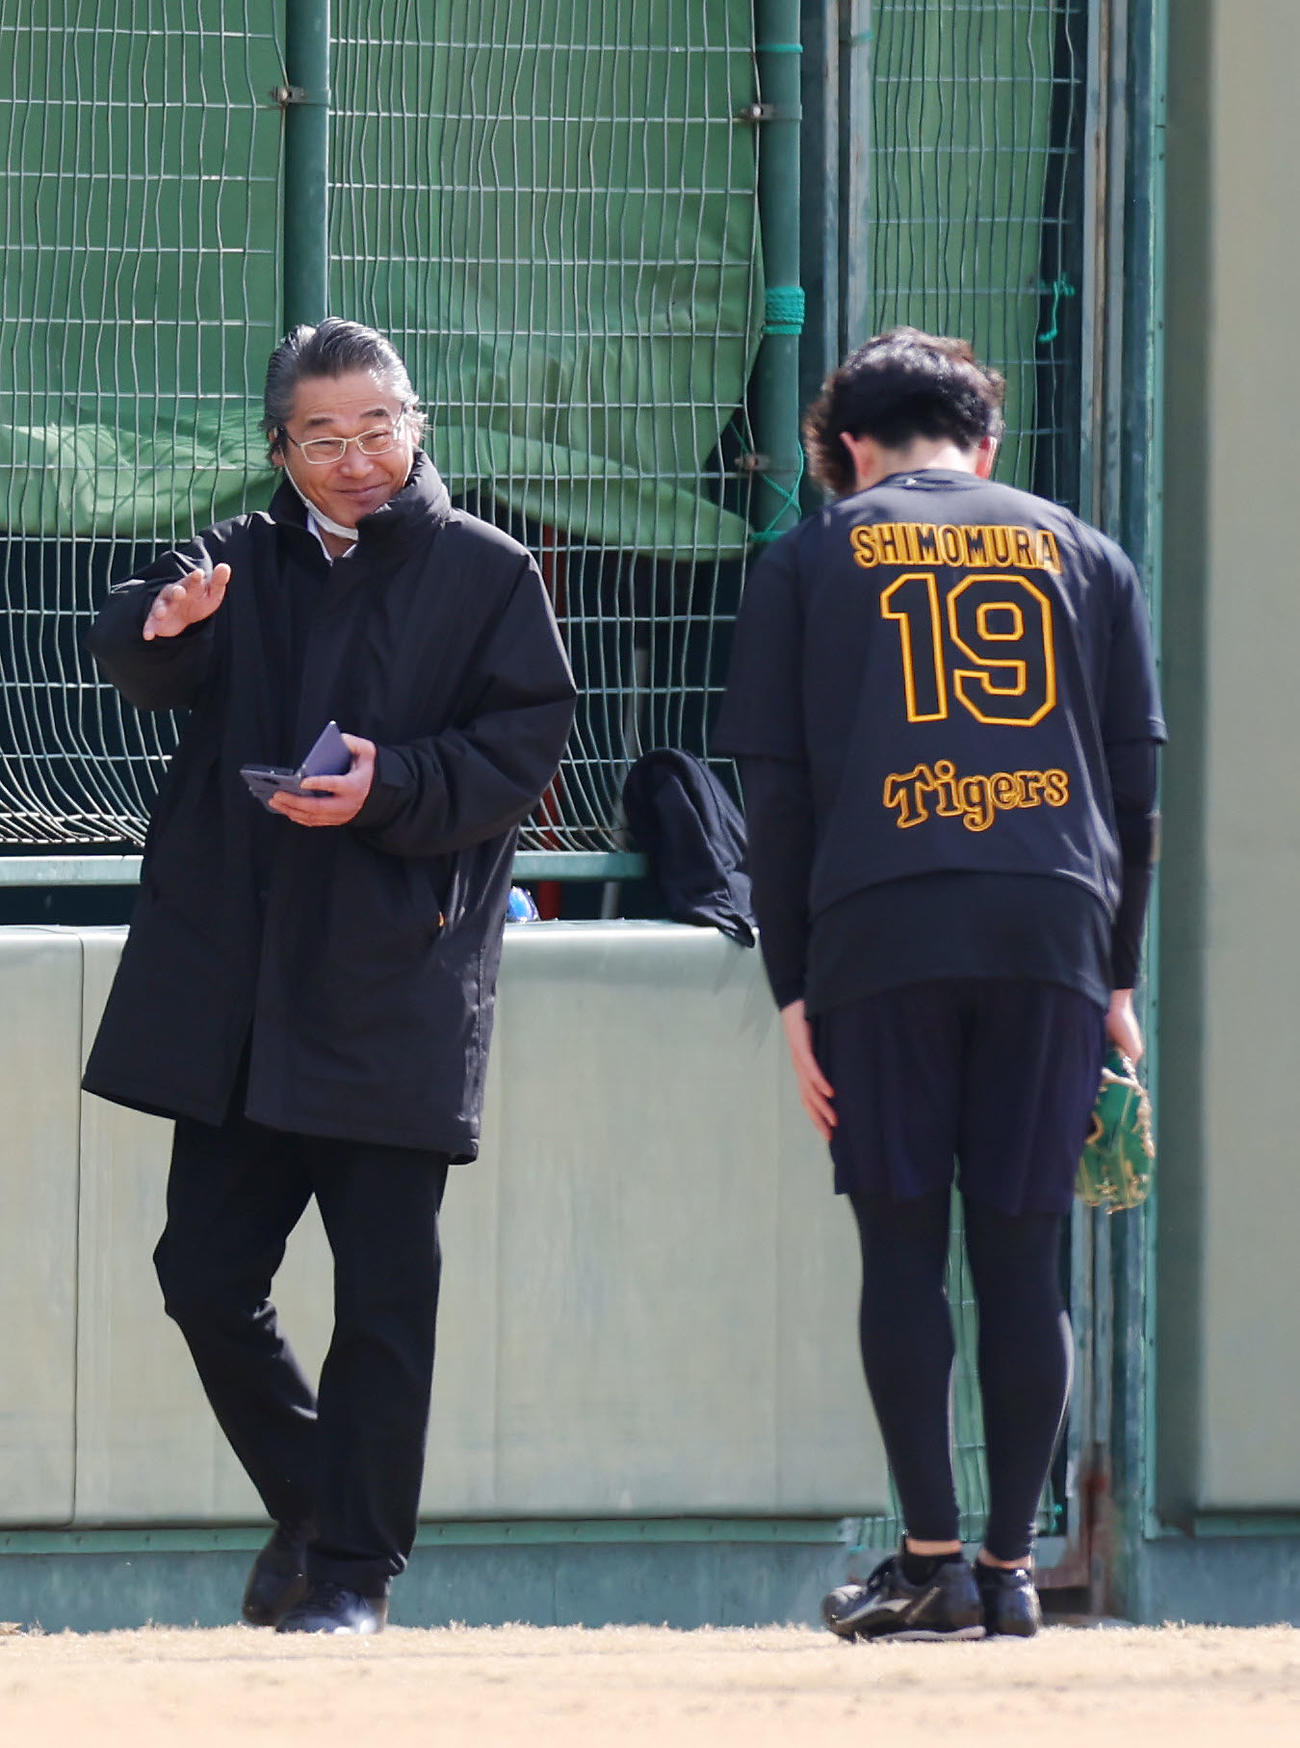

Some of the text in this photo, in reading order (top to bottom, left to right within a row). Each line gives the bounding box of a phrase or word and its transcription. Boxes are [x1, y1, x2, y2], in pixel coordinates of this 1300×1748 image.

[850, 522, 1062, 575] SHIMOMURA
[879, 571, 1057, 728] 19
[882, 759, 1069, 832] Tigers
